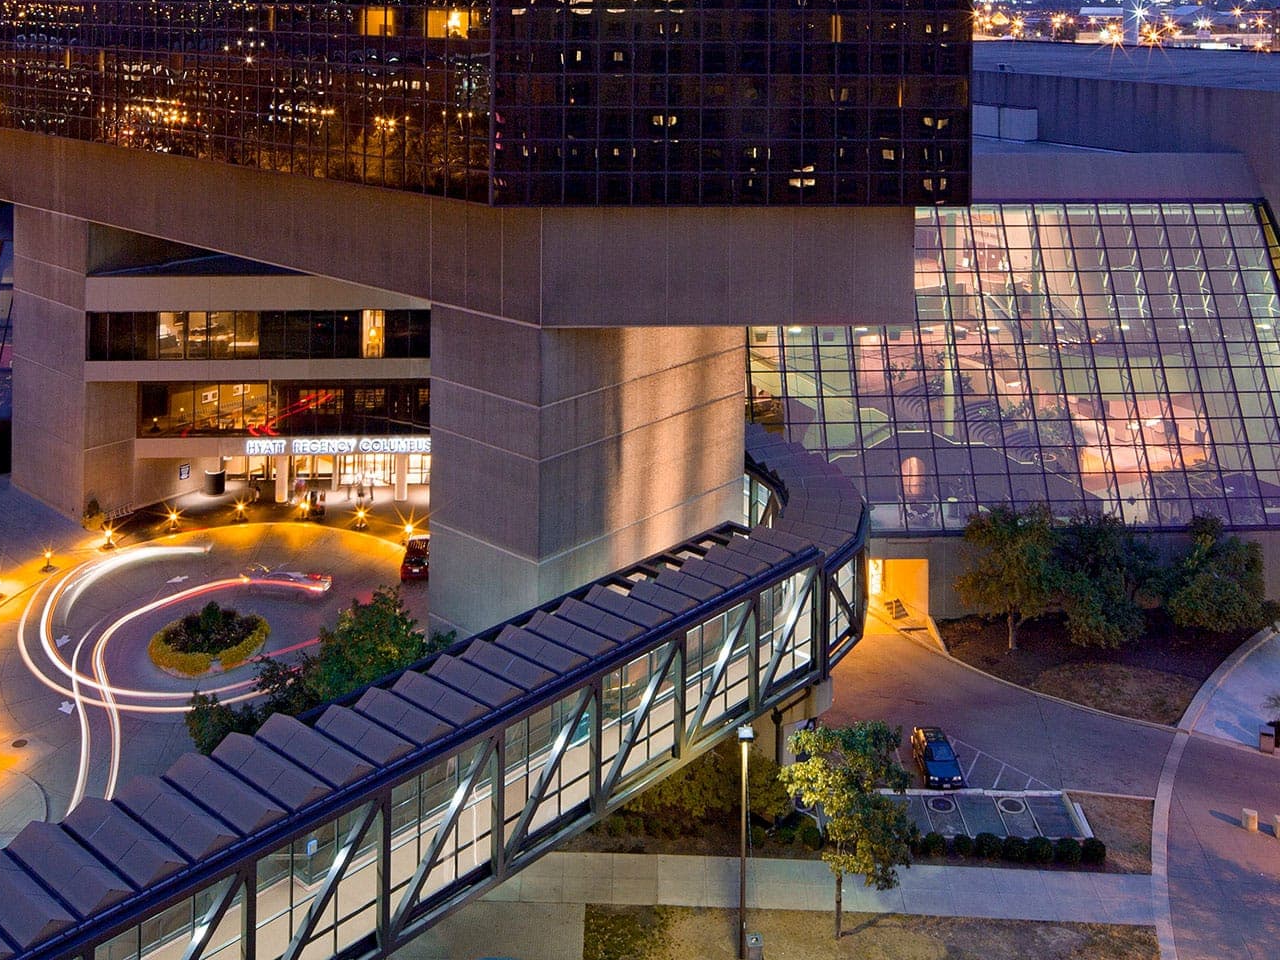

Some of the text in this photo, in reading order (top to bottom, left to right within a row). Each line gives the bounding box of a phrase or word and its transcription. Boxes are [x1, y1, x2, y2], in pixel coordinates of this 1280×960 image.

[247, 438, 431, 454] HYATT REGENCY COLUMBUS
